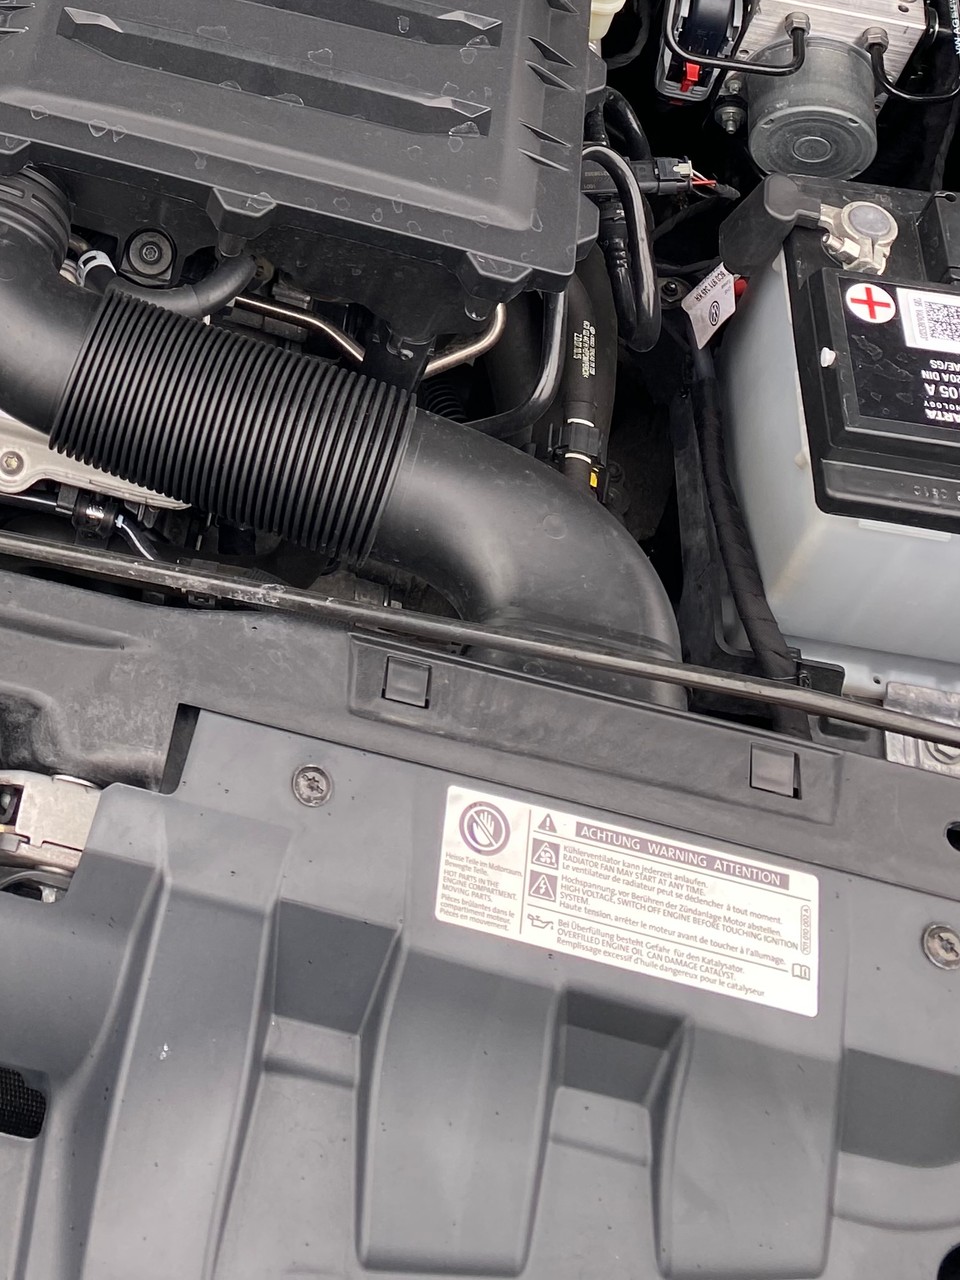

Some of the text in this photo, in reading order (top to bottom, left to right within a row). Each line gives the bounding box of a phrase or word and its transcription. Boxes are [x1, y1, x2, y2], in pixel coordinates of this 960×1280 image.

[921, 369, 940, 381] DIN
[924, 382, 935, 395] A
[444, 859, 472, 873] Bewegte
[465, 856, 479, 865] Teile
[563, 844, 707, 888] Kühlerventilator kann jederzeit anlaufen.
[580, 825, 780, 885] ACHTUNG WARNING ATTENTION
[442, 875, 517, 900] ENGINE COMPARTMENT.
[442, 883, 469, 896] MOVING
[443, 868, 457, 877] HOT
[458, 872, 477, 882] PARTS
[486, 879, 498, 888] THE
[563, 853, 598, 869] RADIATOR
[600, 863, 614, 873] FAN
[616, 867, 632, 877] MAY
[634, 872, 656, 883] START
[668, 880, 683, 891] ANY
[686, 885, 705, 896] TIME.
[439, 900, 484, 918] compartiment
[492, 906, 507, 916] dans
[560, 891, 589, 905] SYSTEM.
[571, 864, 610, 881] ventilateur
[611, 875, 620, 883] de
[622, 877, 654, 892] radiateur
[656, 886, 673, 898] peut
[684, 893, 723, 910] déclencher
[732, 906, 747, 916] tout
[749, 910, 782, 925] moment.
[559, 899, 582, 912] Haute
[584, 906, 613, 921] tension,
[614, 913, 639, 927] arrêter
[648, 923, 675, 937] moteur
[677, 931, 697, 942] avant
[699, 935, 708, 945] de
[710, 938, 737, 952] toucher
[560, 882, 798, 950] HIGH VOLTAGE, SWITCH OFF ENGINE BEFORE TOUCHING IGNITION
[617, 889, 629, 898] vor
[631, 891, 664, 907] Berühren
[665, 901, 677, 910] der
[678, 904, 721, 924] Zündanlage
[723, 915, 746, 928] Motor
[747, 921, 781, 937] abstellen.
[557, 918, 744, 976] Bei Überfüllung besteht Gefahr für den Katalysator.
[557, 927, 736, 981] OVERFILLED ENGINE OIL CAN DAMAGE CATALYST.
[556, 936, 601, 956] Remplissage
[602, 948, 633, 963] excessif
[658, 963, 697, 982] dangereux
[700, 975, 716, 987] pour
[726, 981, 764, 999] catalyseur
